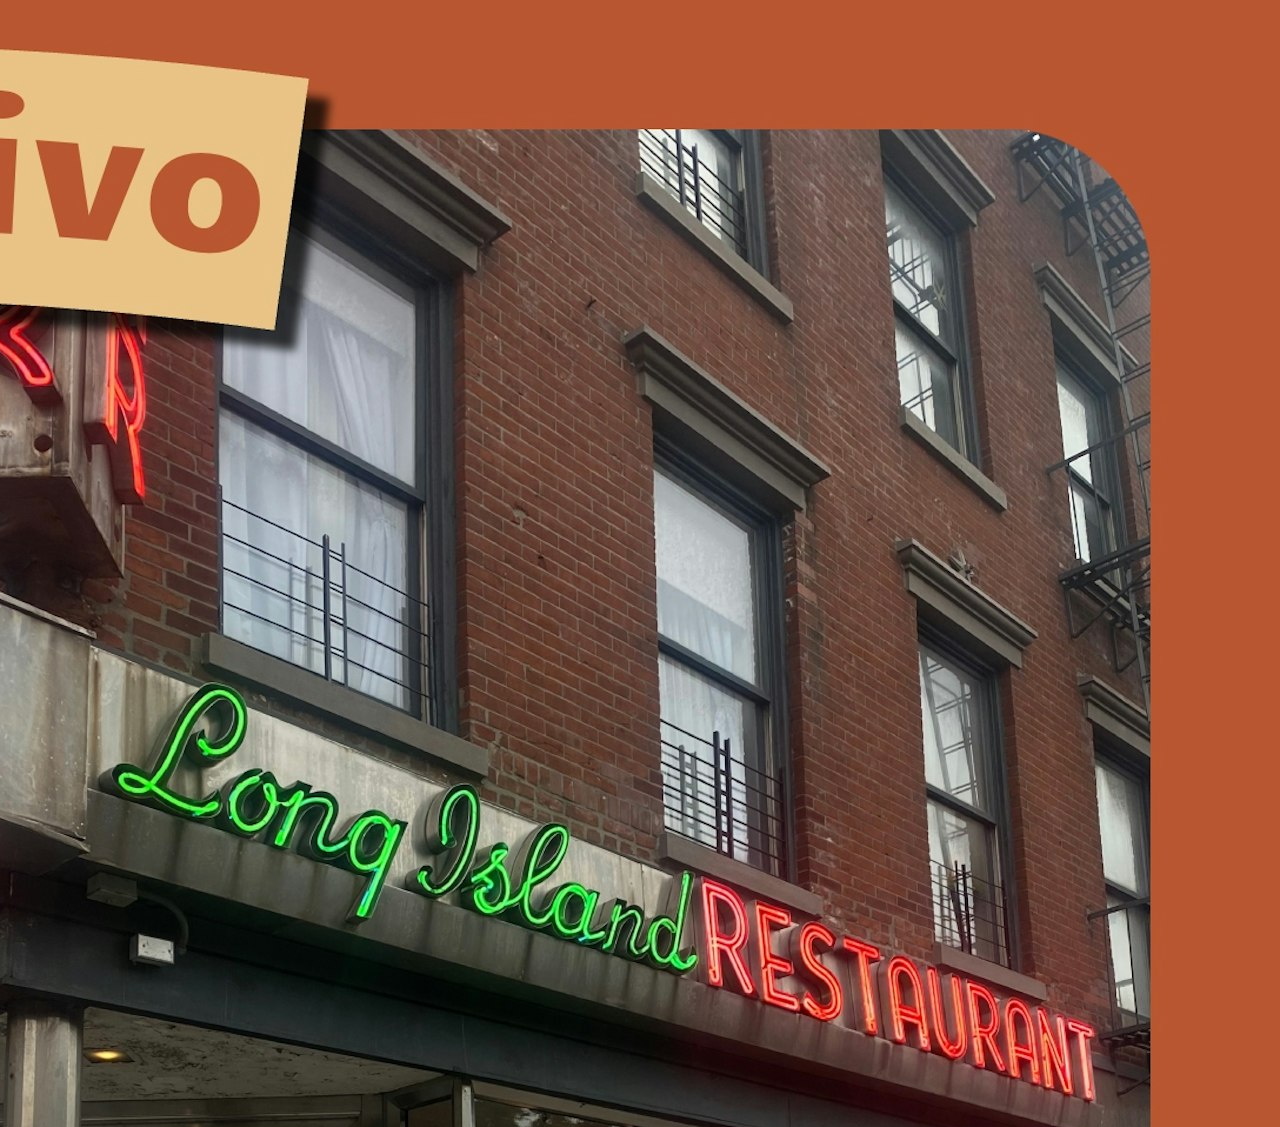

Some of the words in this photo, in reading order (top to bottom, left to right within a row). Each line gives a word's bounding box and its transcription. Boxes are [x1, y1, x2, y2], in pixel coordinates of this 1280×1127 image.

[114, 685, 404, 920] Long
[415, 784, 699, 972] Island
[700, 876, 1097, 1101] RESTAURANT
